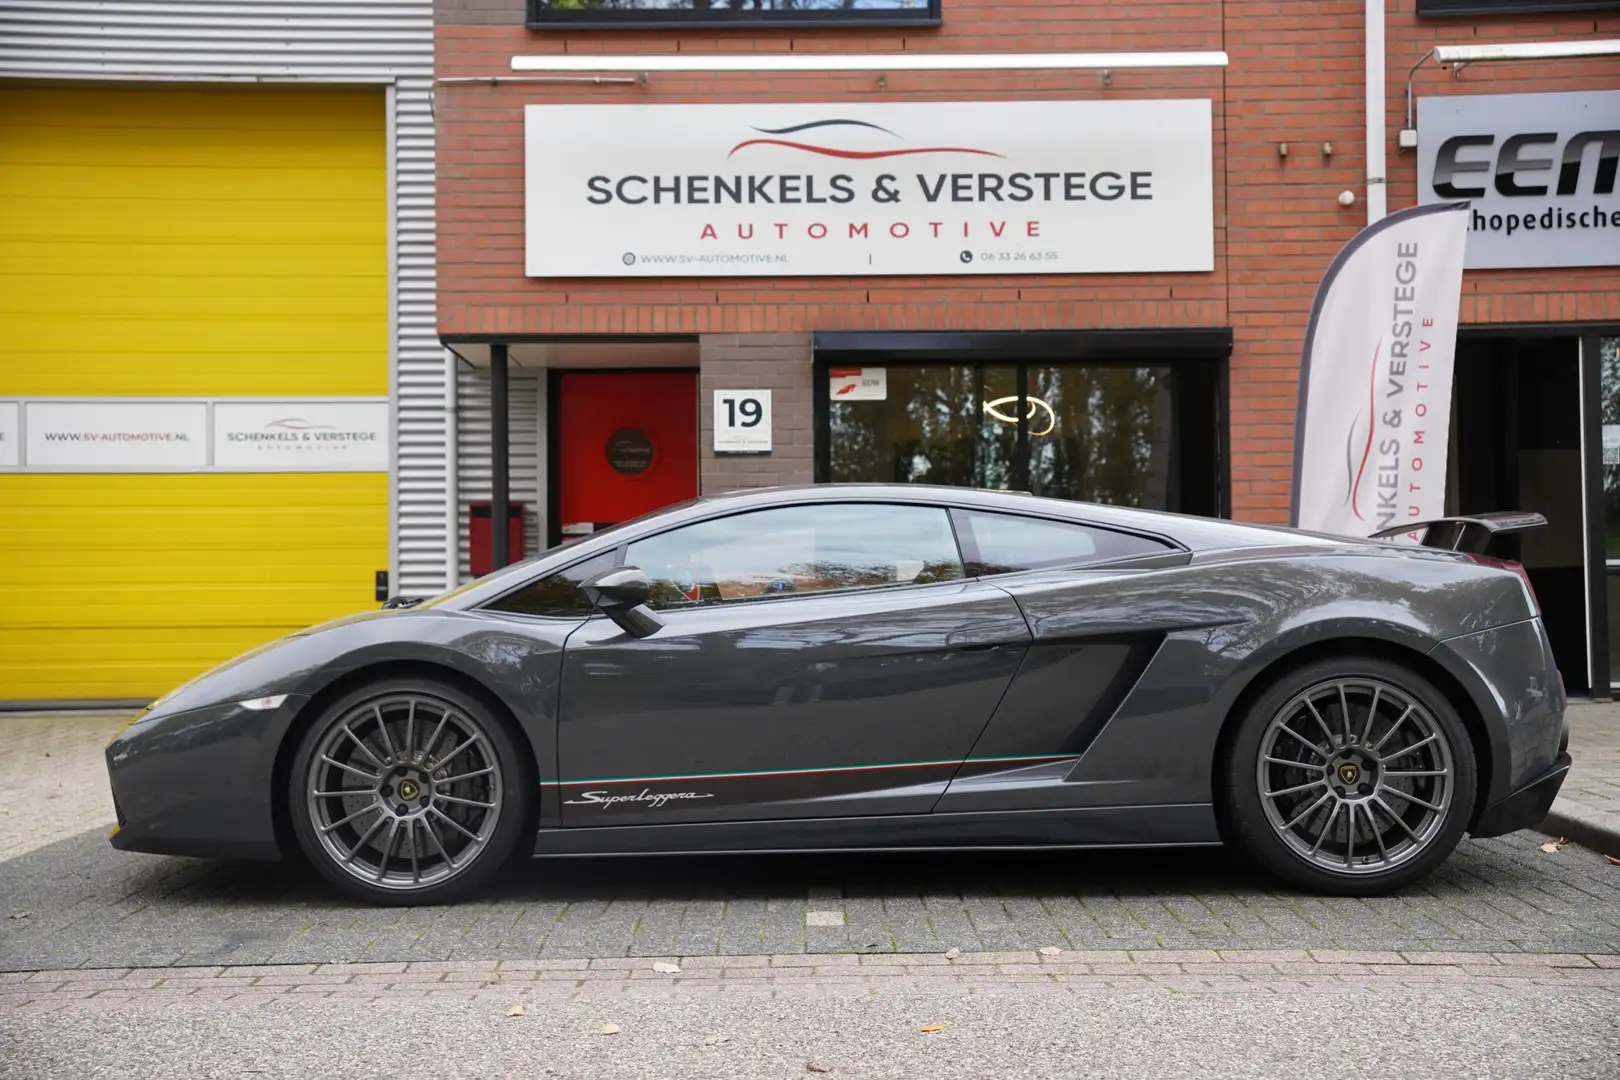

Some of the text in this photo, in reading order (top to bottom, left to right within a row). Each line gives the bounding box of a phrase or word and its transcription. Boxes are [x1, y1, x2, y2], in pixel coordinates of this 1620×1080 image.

[587, 171, 1153, 205] SCHENKELS & VERSTEGE
[700, 220, 1040, 240] AUTOMOTIVE
[1467, 205, 1620, 236] hopedische
[641, 253, 789, 264] WWW.SV-AUTOMOTIVE.NL
[1376, 242, 1418, 541] NKELS & VERSTEGE
[722, 398, 763, 428] 19
[45, 432, 190, 442] WWW.SV-AUTOMOTIVE.NL
[227, 432, 377, 441] SCHENKELS & VERSTEGE
[564, 788, 715, 810] Superleggera
